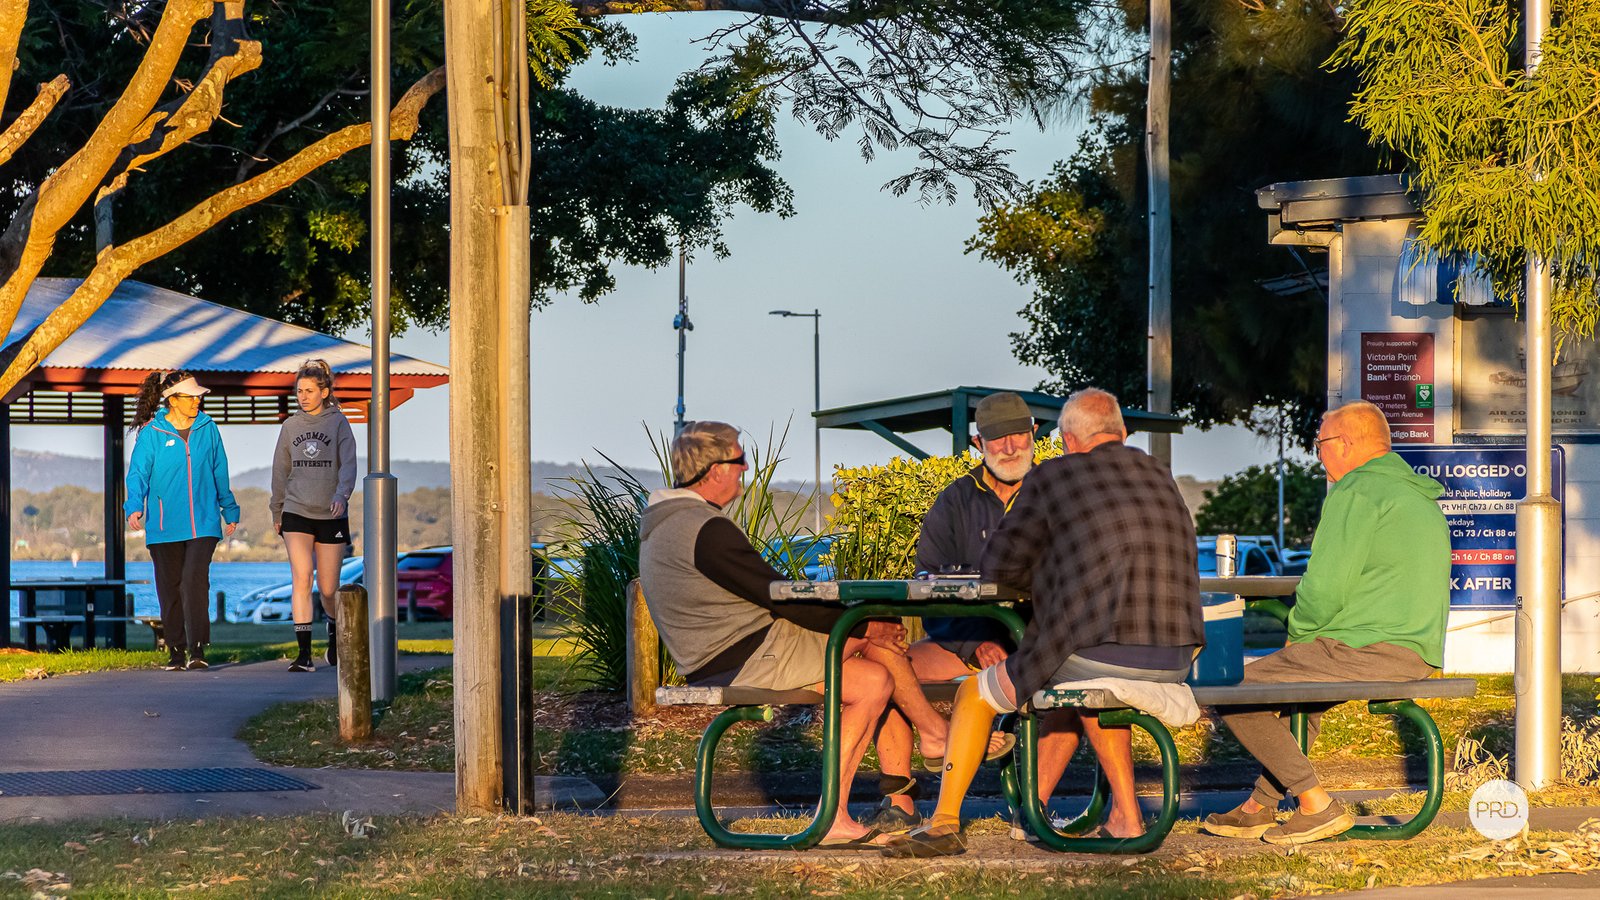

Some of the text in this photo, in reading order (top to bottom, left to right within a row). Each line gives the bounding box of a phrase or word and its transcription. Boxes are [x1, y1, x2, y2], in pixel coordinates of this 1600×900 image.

[1367, 353, 1418, 361] Victoria Point
[1367, 363, 1412, 373] Community
[1394, 373, 1421, 381] Branch
[292, 431, 331, 447] COLUMBIA
[1390, 430, 1430, 439] ndigo Bank
[1445, 464, 1510, 478] LOGGED
[1455, 489, 1478, 498] Public
[1479, 488, 1512, 498] Holidays
[1441, 503, 1449, 511] Pt
[1452, 503, 1467, 511] VHF
[1494, 503, 1504, 511] Ch
[1453, 529, 1464, 537] Ch
[1465, 529, 1476, 537] 73
[1483, 529, 1494, 537] Ch
[1495, 529, 1506, 537] 88
[1462, 553, 1472, 561] 16
[1480, 553, 1491, 561] Ch
[1492, 553, 1503, 561] 88
[1463, 577, 1512, 591] AFTER
